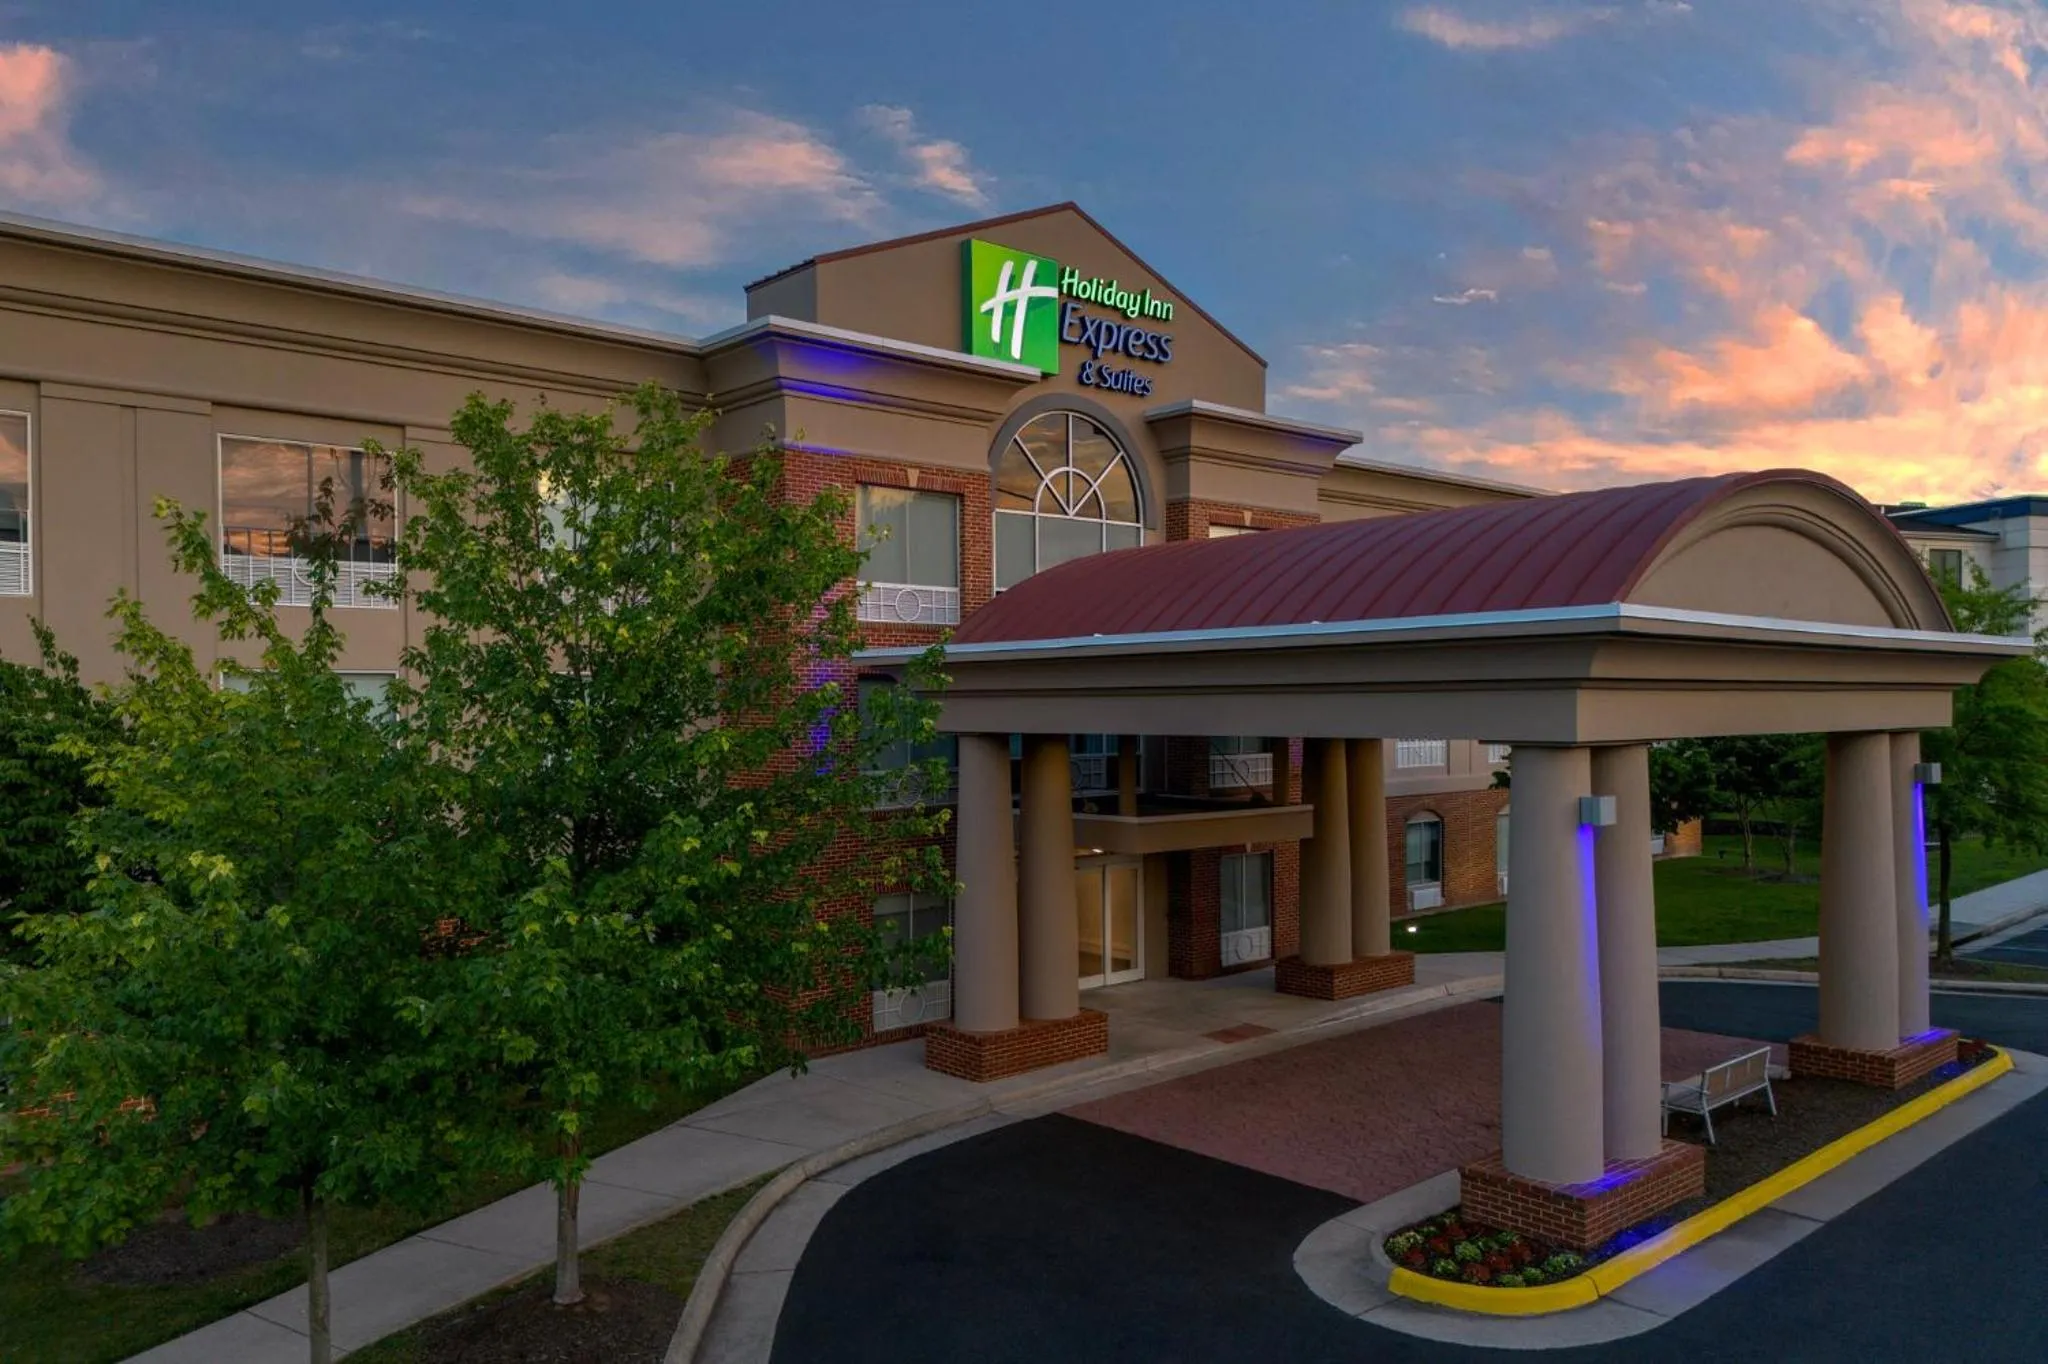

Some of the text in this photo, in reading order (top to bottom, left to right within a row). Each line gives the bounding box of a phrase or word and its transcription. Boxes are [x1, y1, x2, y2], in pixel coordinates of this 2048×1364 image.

[1061, 266, 1173, 321] Holiday Inn
[1062, 302, 1173, 363] Express
[1081, 360, 1152, 396] & Suites
